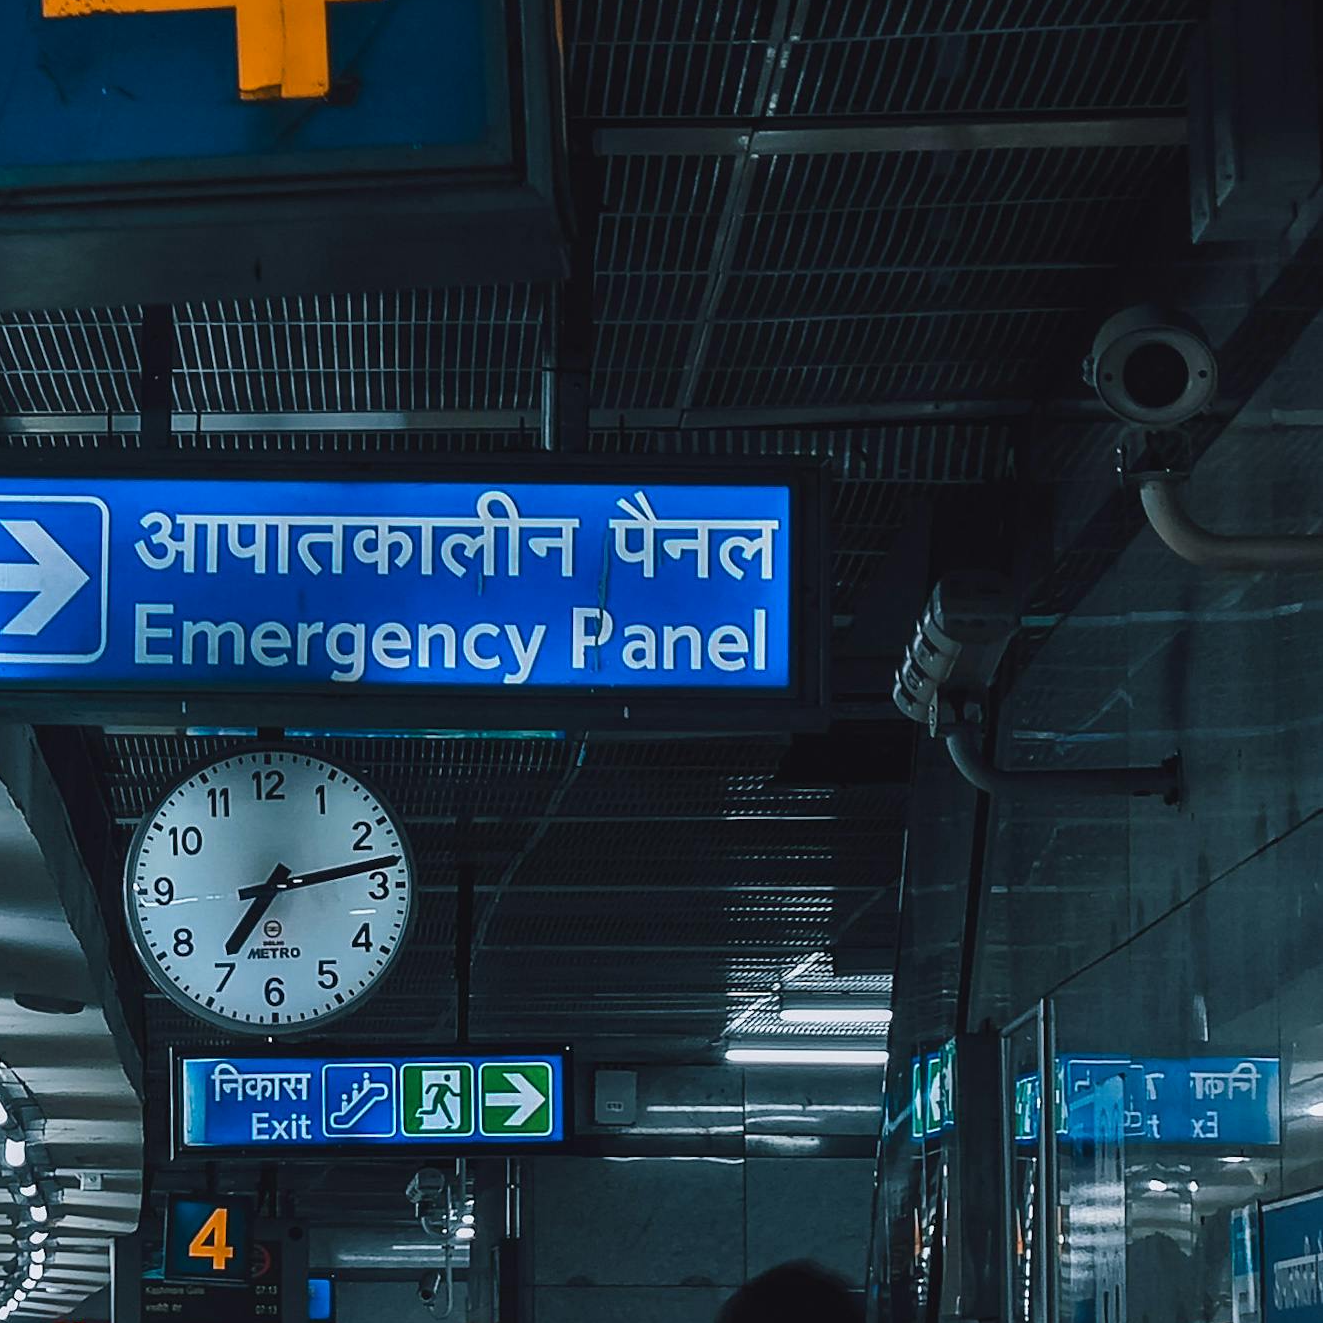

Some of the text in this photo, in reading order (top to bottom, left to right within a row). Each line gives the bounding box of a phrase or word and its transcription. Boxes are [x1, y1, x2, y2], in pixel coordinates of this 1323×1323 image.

[134, 490, 780, 580] आपातकालीन पैनल
[134, 603, 767, 685] Emergency Panel
[251, 770, 285, 800] 12
[315, 784, 326, 815] 1
[207, 787, 230, 818] 11
[168, 826, 203, 856] 10
[352, 820, 373, 851] 2
[154, 877, 174, 906] 9
[367, 871, 390, 900] 3
[173, 928, 194, 957] 8
[247, 947, 301, 959] METRO
[351, 923, 373, 953] 4
[214, 962, 236, 993] 7
[318, 960, 339, 990] 5
[264, 977, 285, 1007] 6
[211, 1063, 312, 1102] निकास
[251, 1112, 312, 1140] Exit
[189, 1208, 234, 1270] 4
